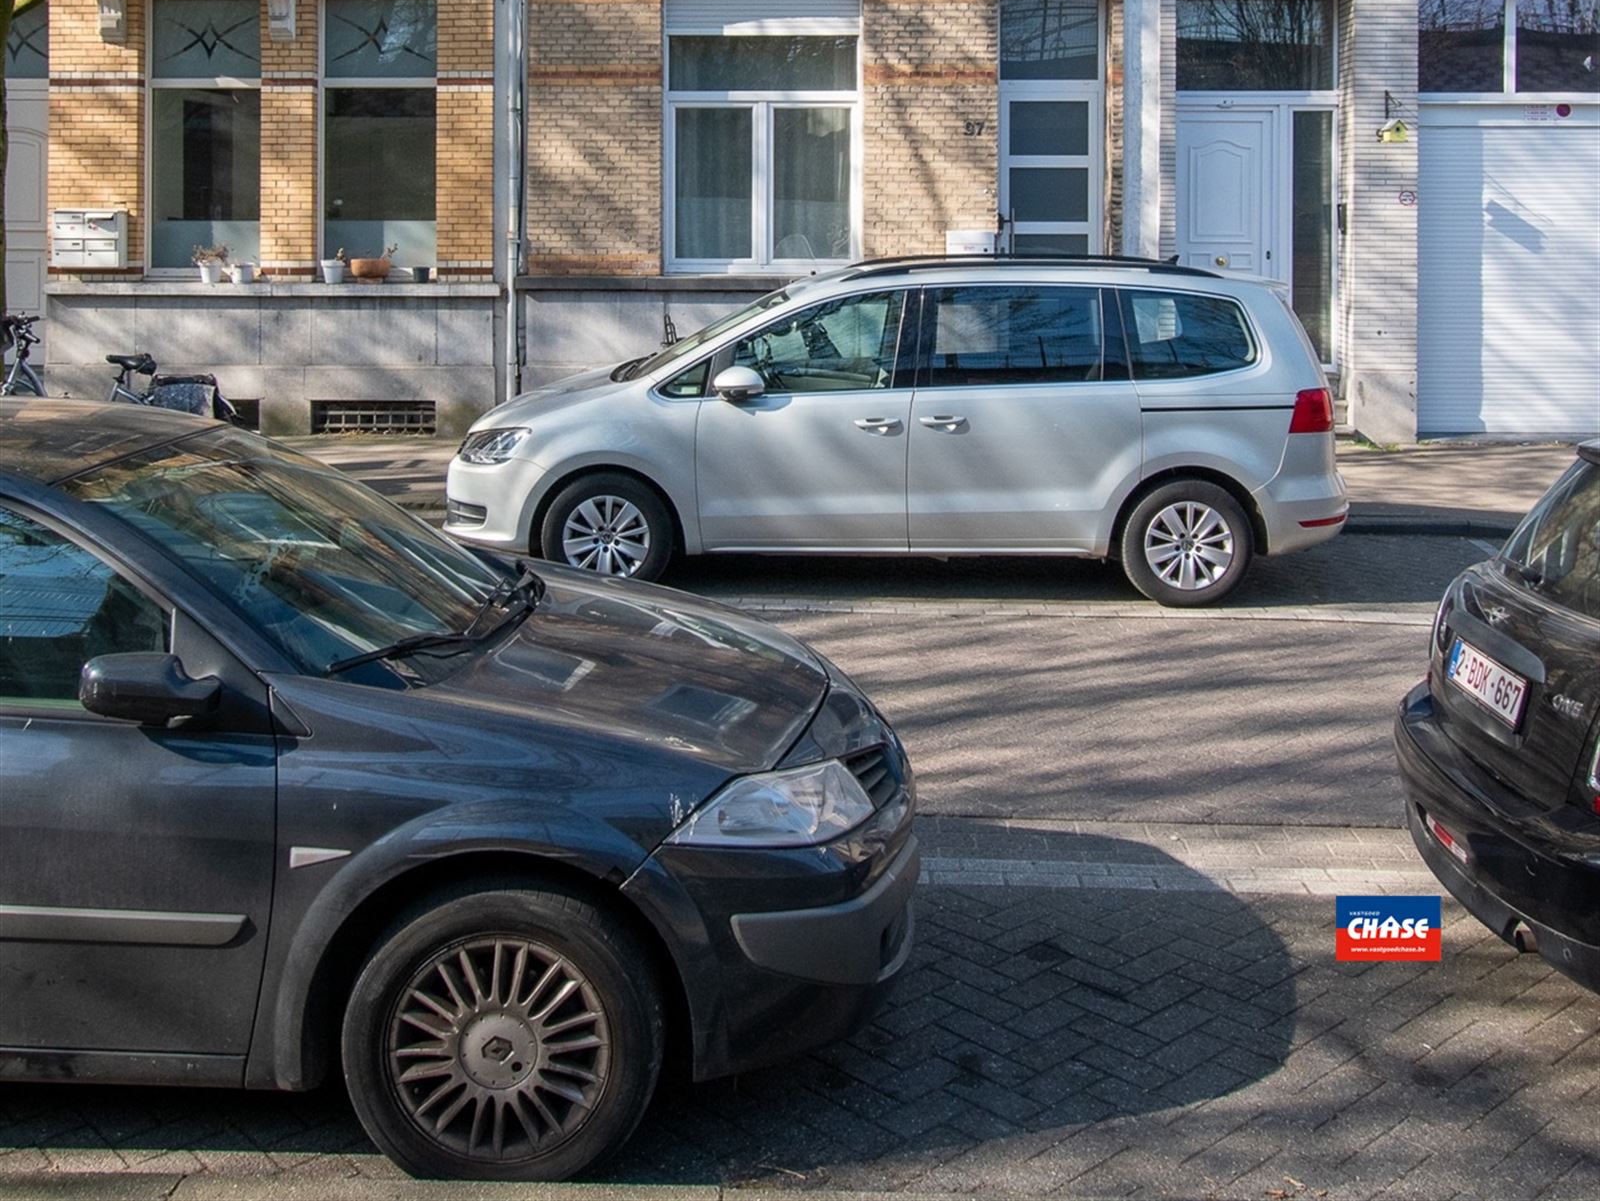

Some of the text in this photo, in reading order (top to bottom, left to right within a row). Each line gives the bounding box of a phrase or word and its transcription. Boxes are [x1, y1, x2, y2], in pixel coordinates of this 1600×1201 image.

[964, 121, 985, 136] 97
[1456, 649, 1521, 714] 2-BDK-667
[1552, 693, 1584, 718] ONE
